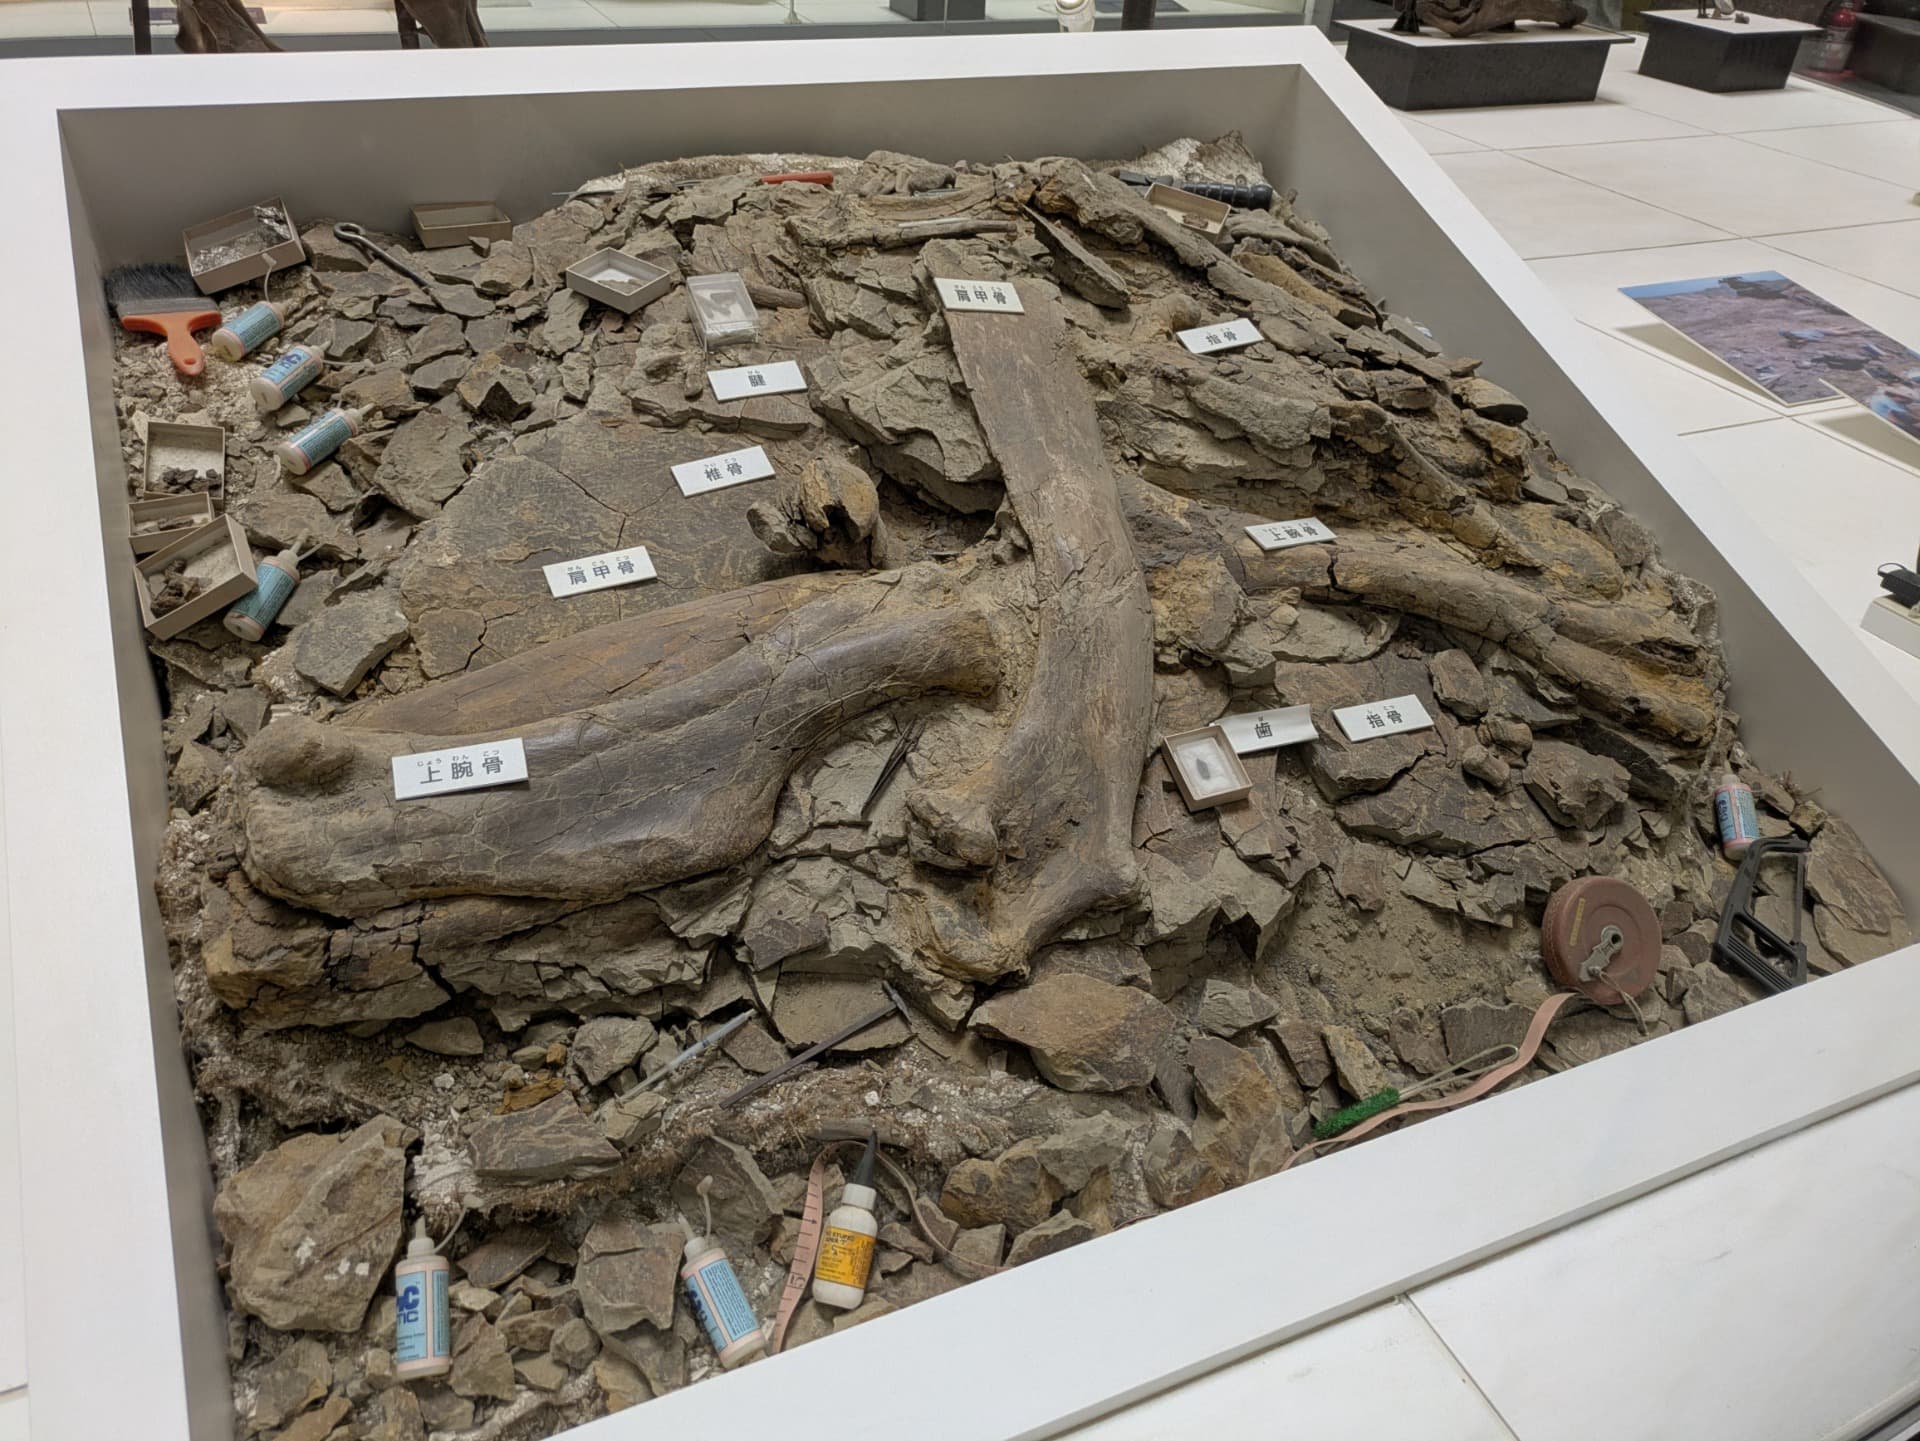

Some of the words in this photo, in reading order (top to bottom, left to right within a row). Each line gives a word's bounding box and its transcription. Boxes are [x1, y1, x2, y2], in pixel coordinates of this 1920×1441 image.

[955, 289, 1007, 305] 肩甲骨
[1205, 331, 1238, 346] 指骨
[748, 374, 767, 388] 腱
[704, 462, 743, 482] 椎骨
[1272, 524, 1319, 542] 上腕骨
[567, 560, 633, 585] 肩甲骨
[1366, 710, 1403, 729] 指骨
[1254, 722, 1273, 739] 歯
[419, 756, 504, 785] 上腕骨
